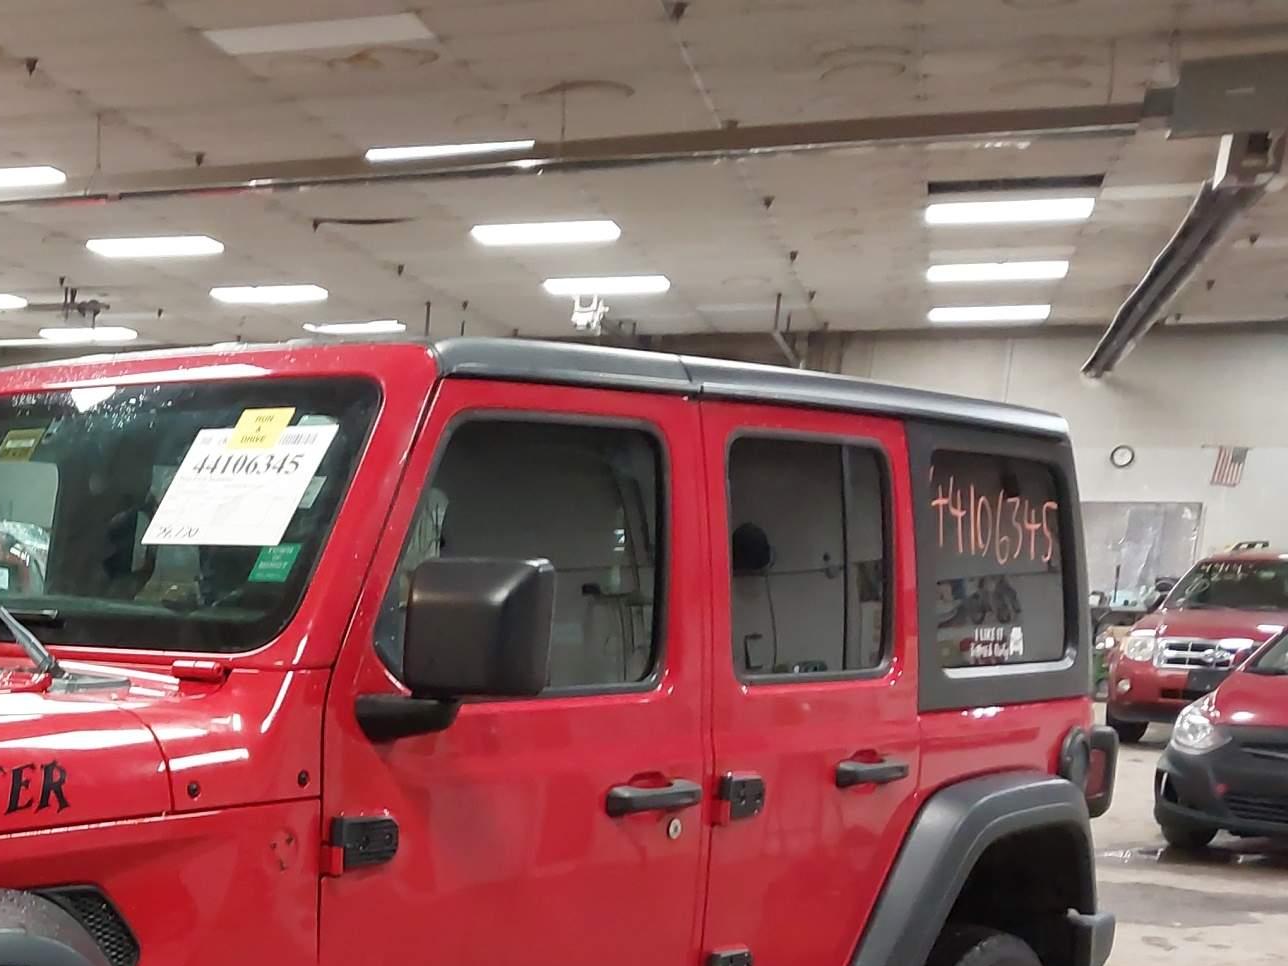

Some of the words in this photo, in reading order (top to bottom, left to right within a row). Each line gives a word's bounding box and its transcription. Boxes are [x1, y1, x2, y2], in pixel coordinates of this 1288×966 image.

[254, 415, 275, 423] RUN
[240, 435, 266, 444] DRIVE
[192, 453, 305, 475] 44106345
[979, 627, 995, 641] LIKE
